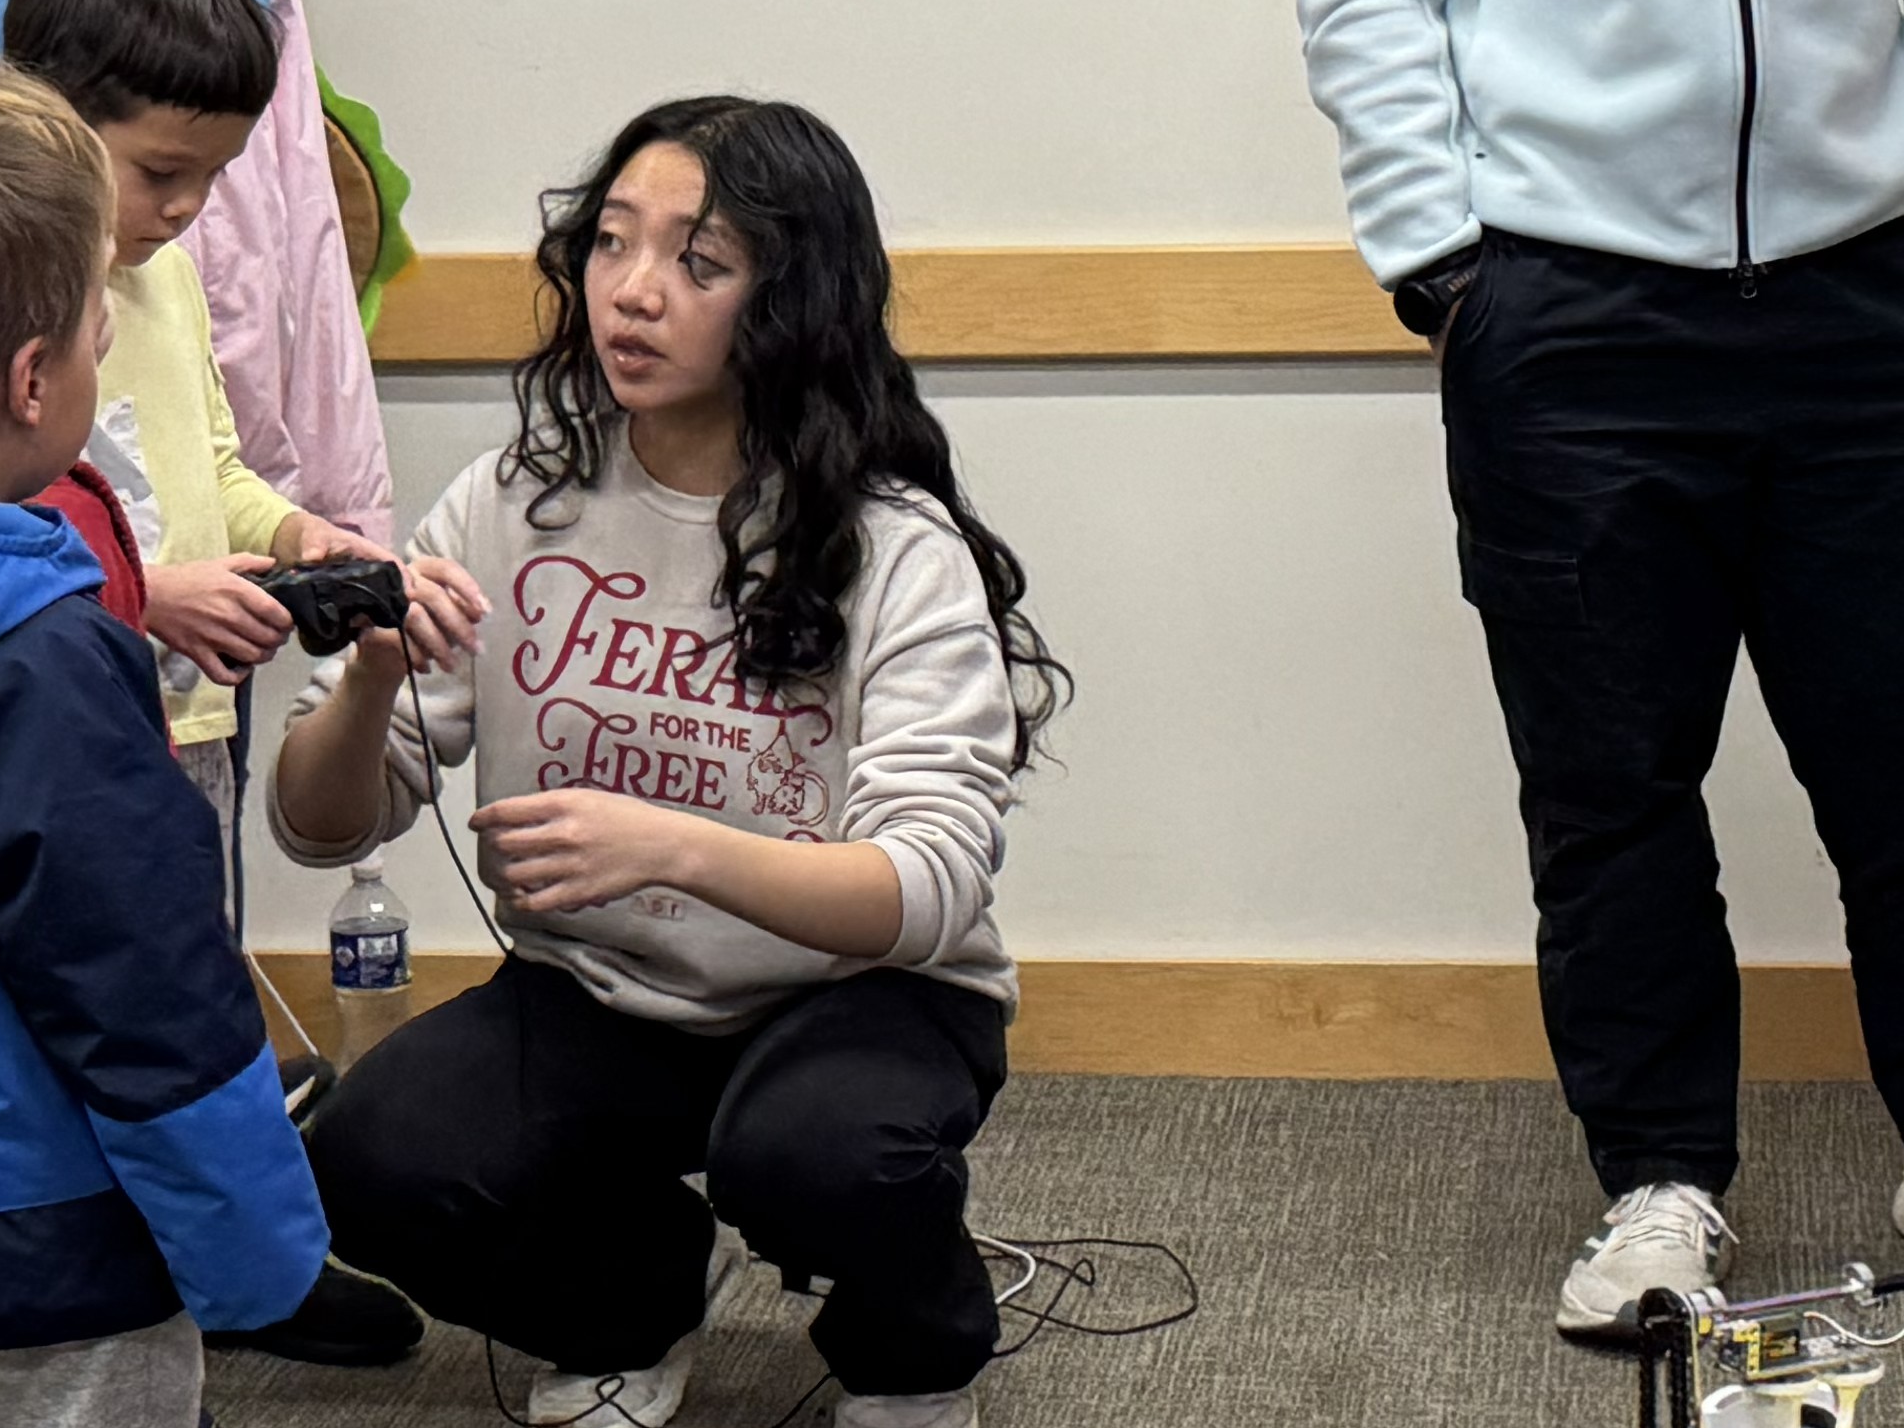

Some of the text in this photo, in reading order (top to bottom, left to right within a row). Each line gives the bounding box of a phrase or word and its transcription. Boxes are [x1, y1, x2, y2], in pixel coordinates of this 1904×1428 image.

[537, 697, 728, 812] FREE
[649, 711, 752, 753] FOR THE
